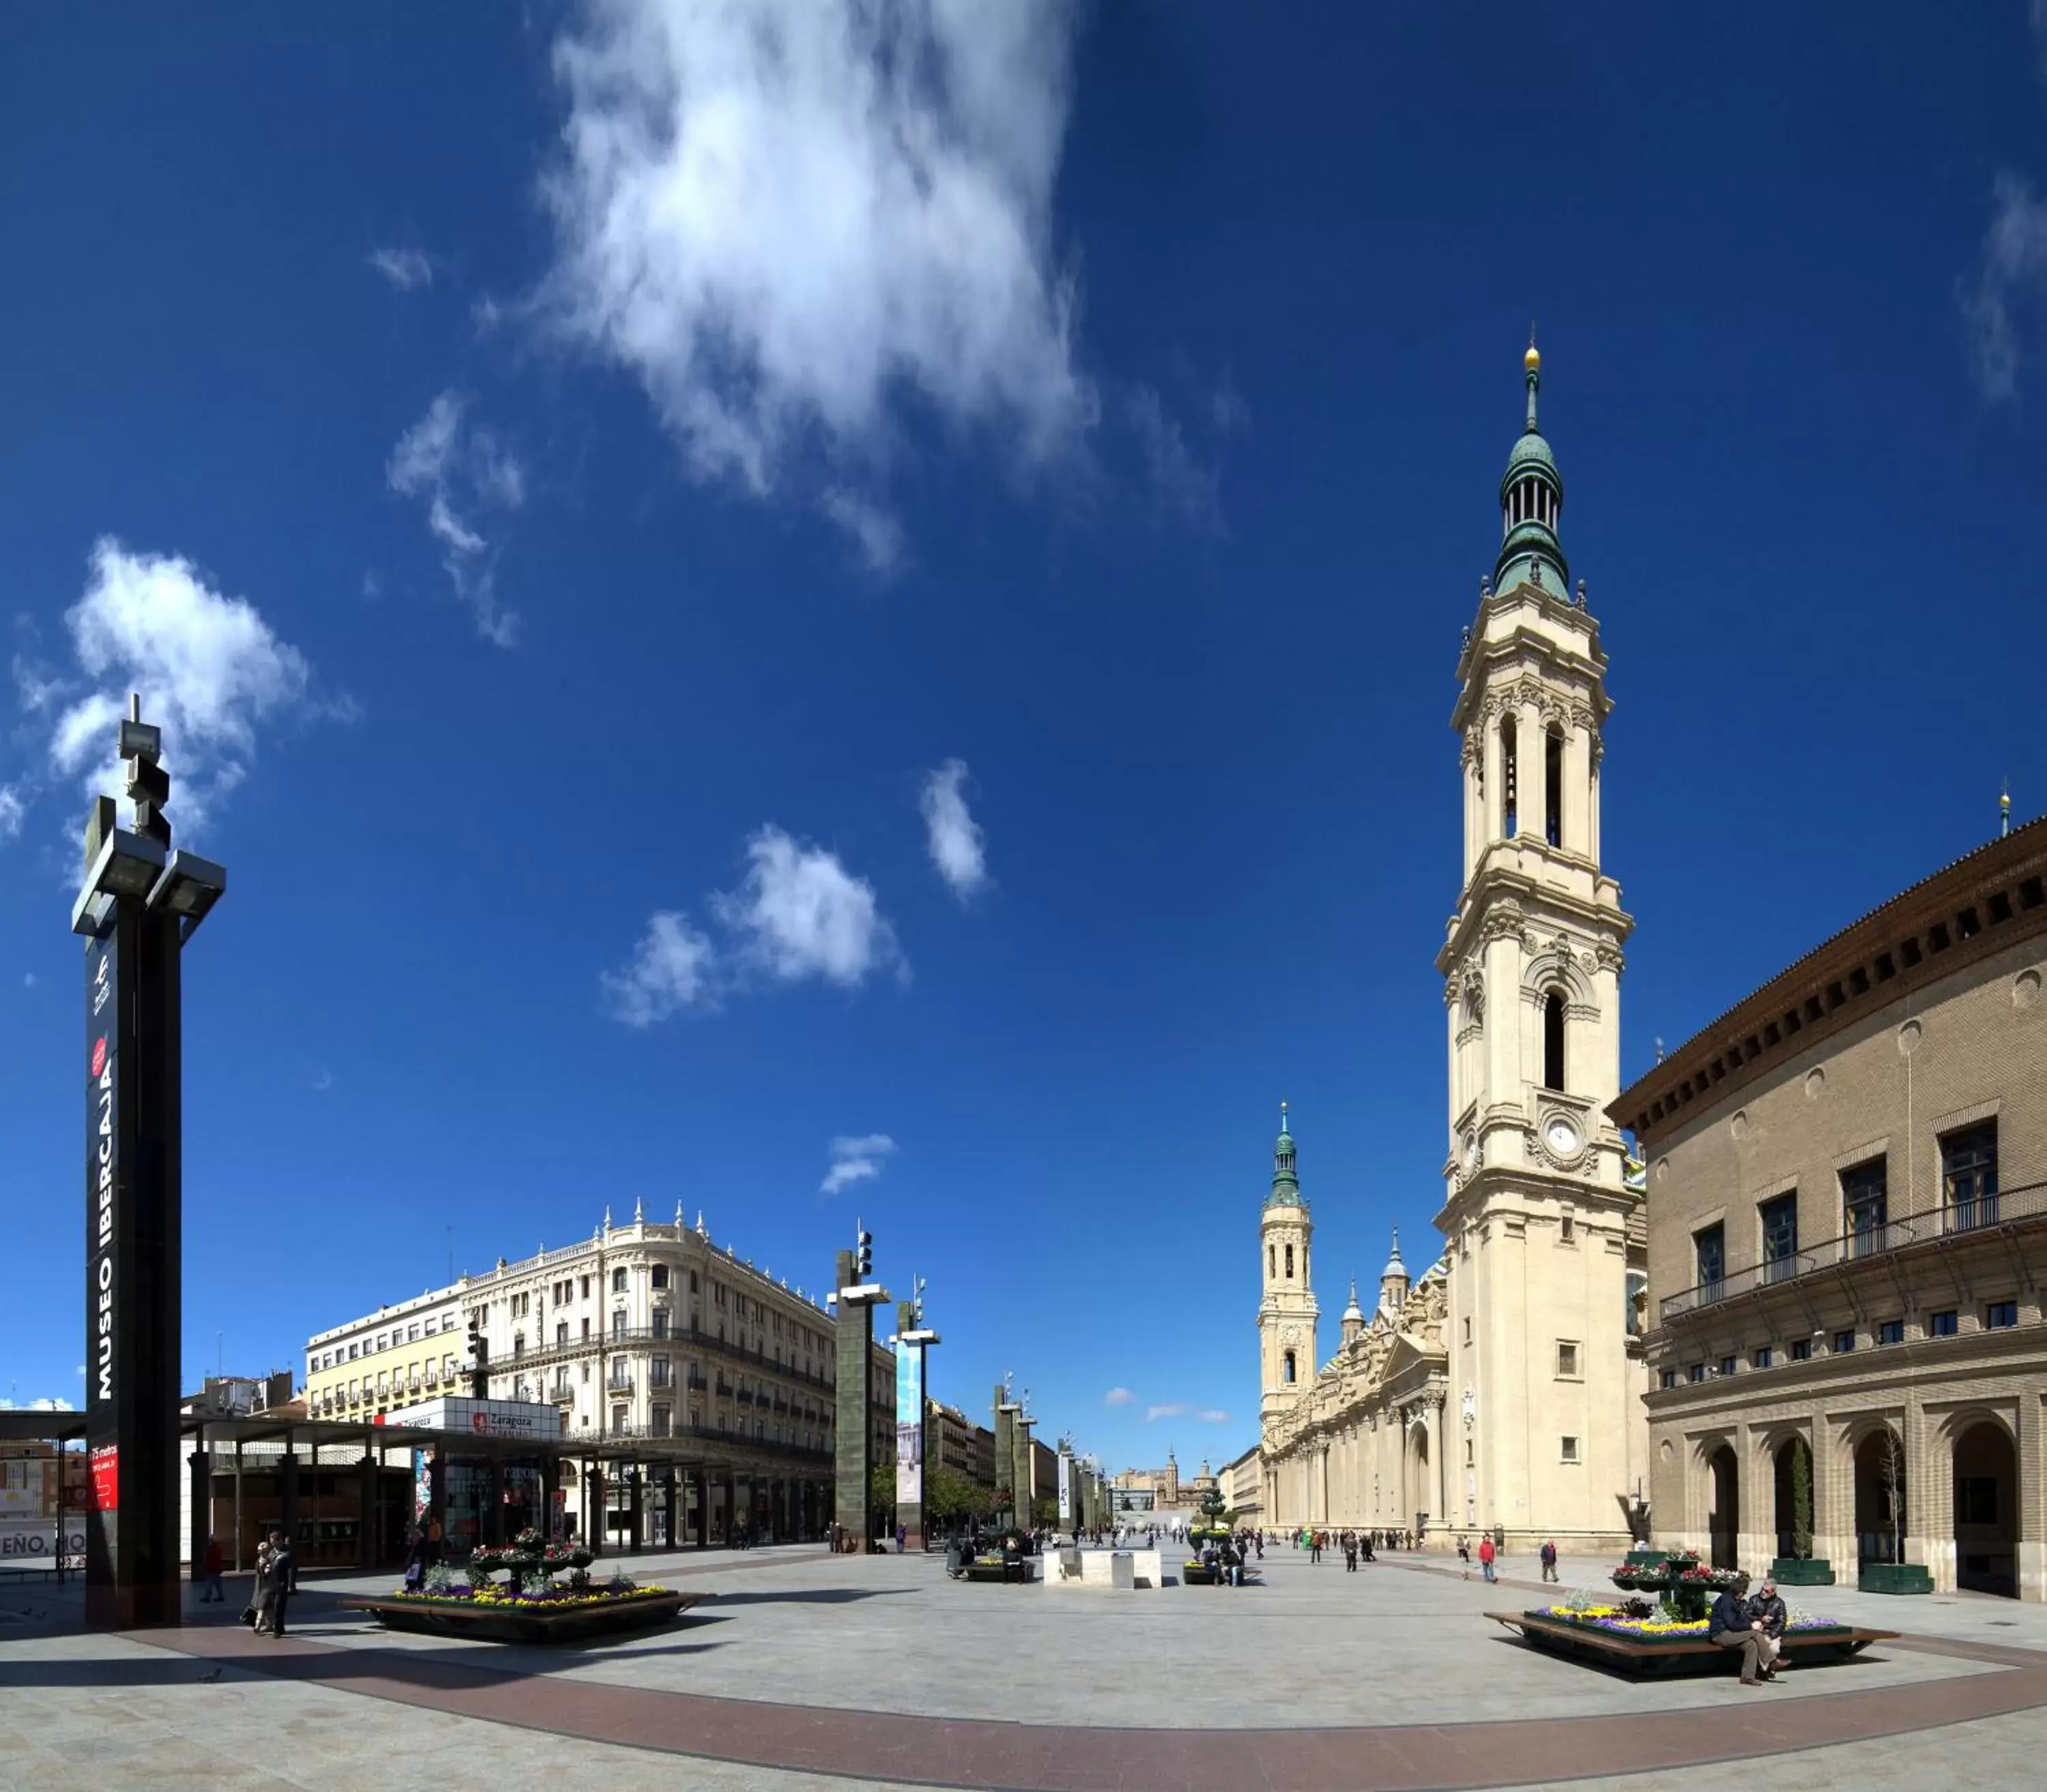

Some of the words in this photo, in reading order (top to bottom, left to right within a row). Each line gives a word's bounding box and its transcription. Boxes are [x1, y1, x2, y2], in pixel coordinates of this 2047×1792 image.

[99, 1058, 113, 1247] IBERCAJA
[99, 1257, 112, 1400] MUSEO
[491, 1413, 532, 1428] Zaragoza
